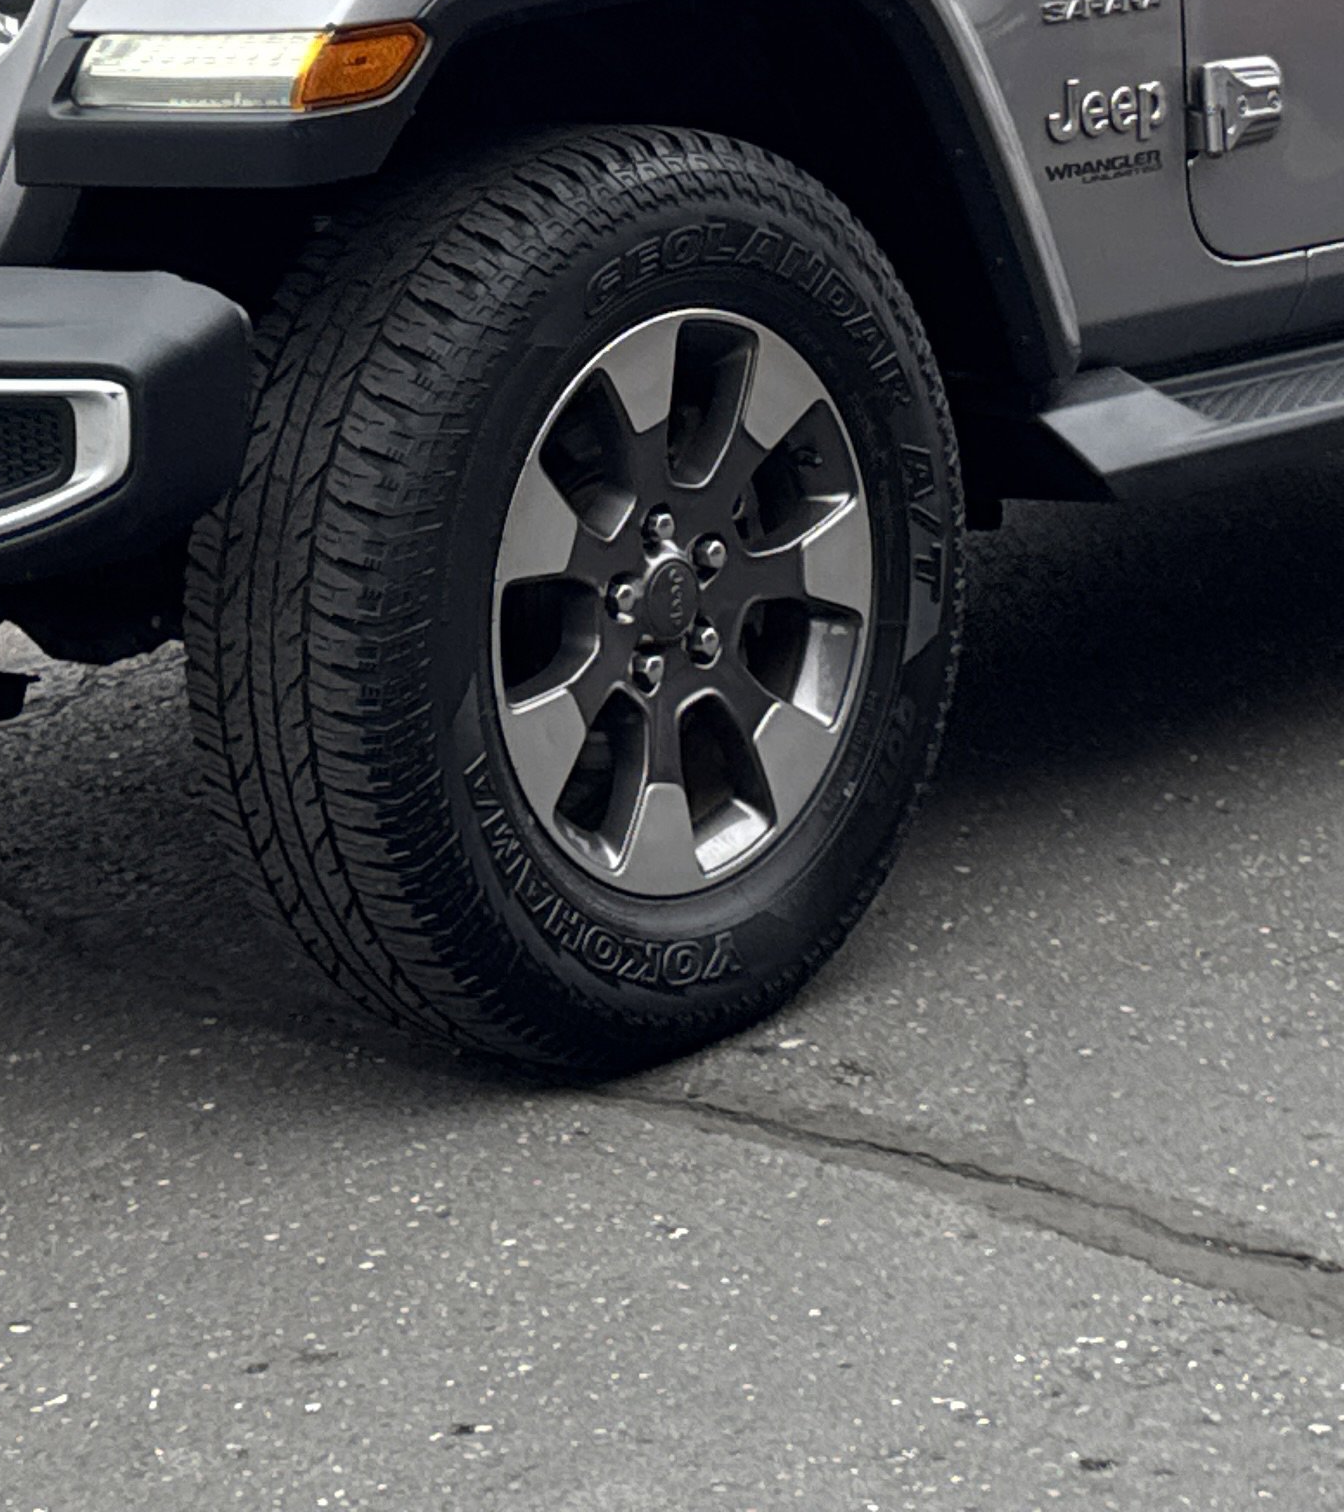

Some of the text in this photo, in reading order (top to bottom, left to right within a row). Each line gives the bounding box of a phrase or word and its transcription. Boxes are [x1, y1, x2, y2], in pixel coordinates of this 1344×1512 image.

[1046, 79, 1166, 143] Jeep
[1045, 149, 1161, 182] WRANGLER
[462, 751, 742, 987] YOKOHAMA
